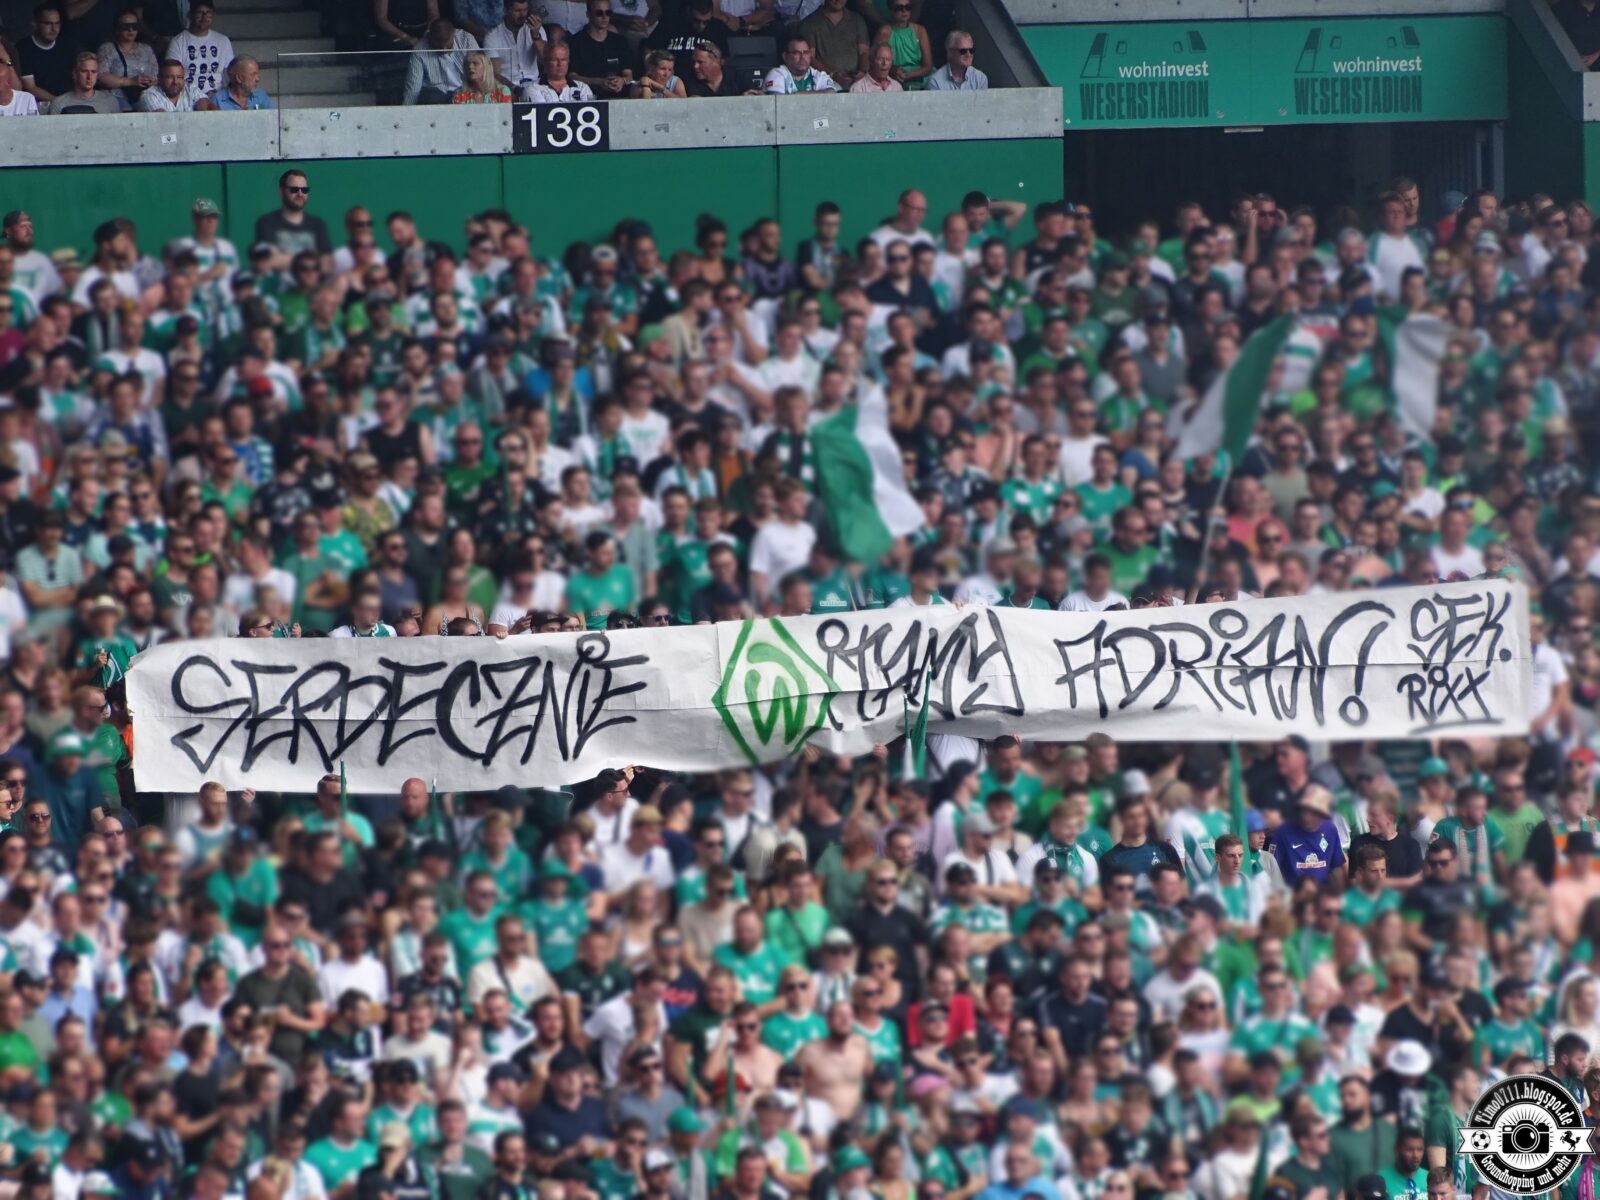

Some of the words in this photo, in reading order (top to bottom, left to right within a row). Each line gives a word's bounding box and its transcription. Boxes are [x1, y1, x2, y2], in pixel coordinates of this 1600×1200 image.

[1118, 60, 1209, 79] wohninvest
[1333, 56, 1423, 74] wohninvest
[1079, 80, 1209, 121] WESERSTADION
[1293, 75, 1423, 116] WESERSTADION
[520, 106, 602, 148] 138
